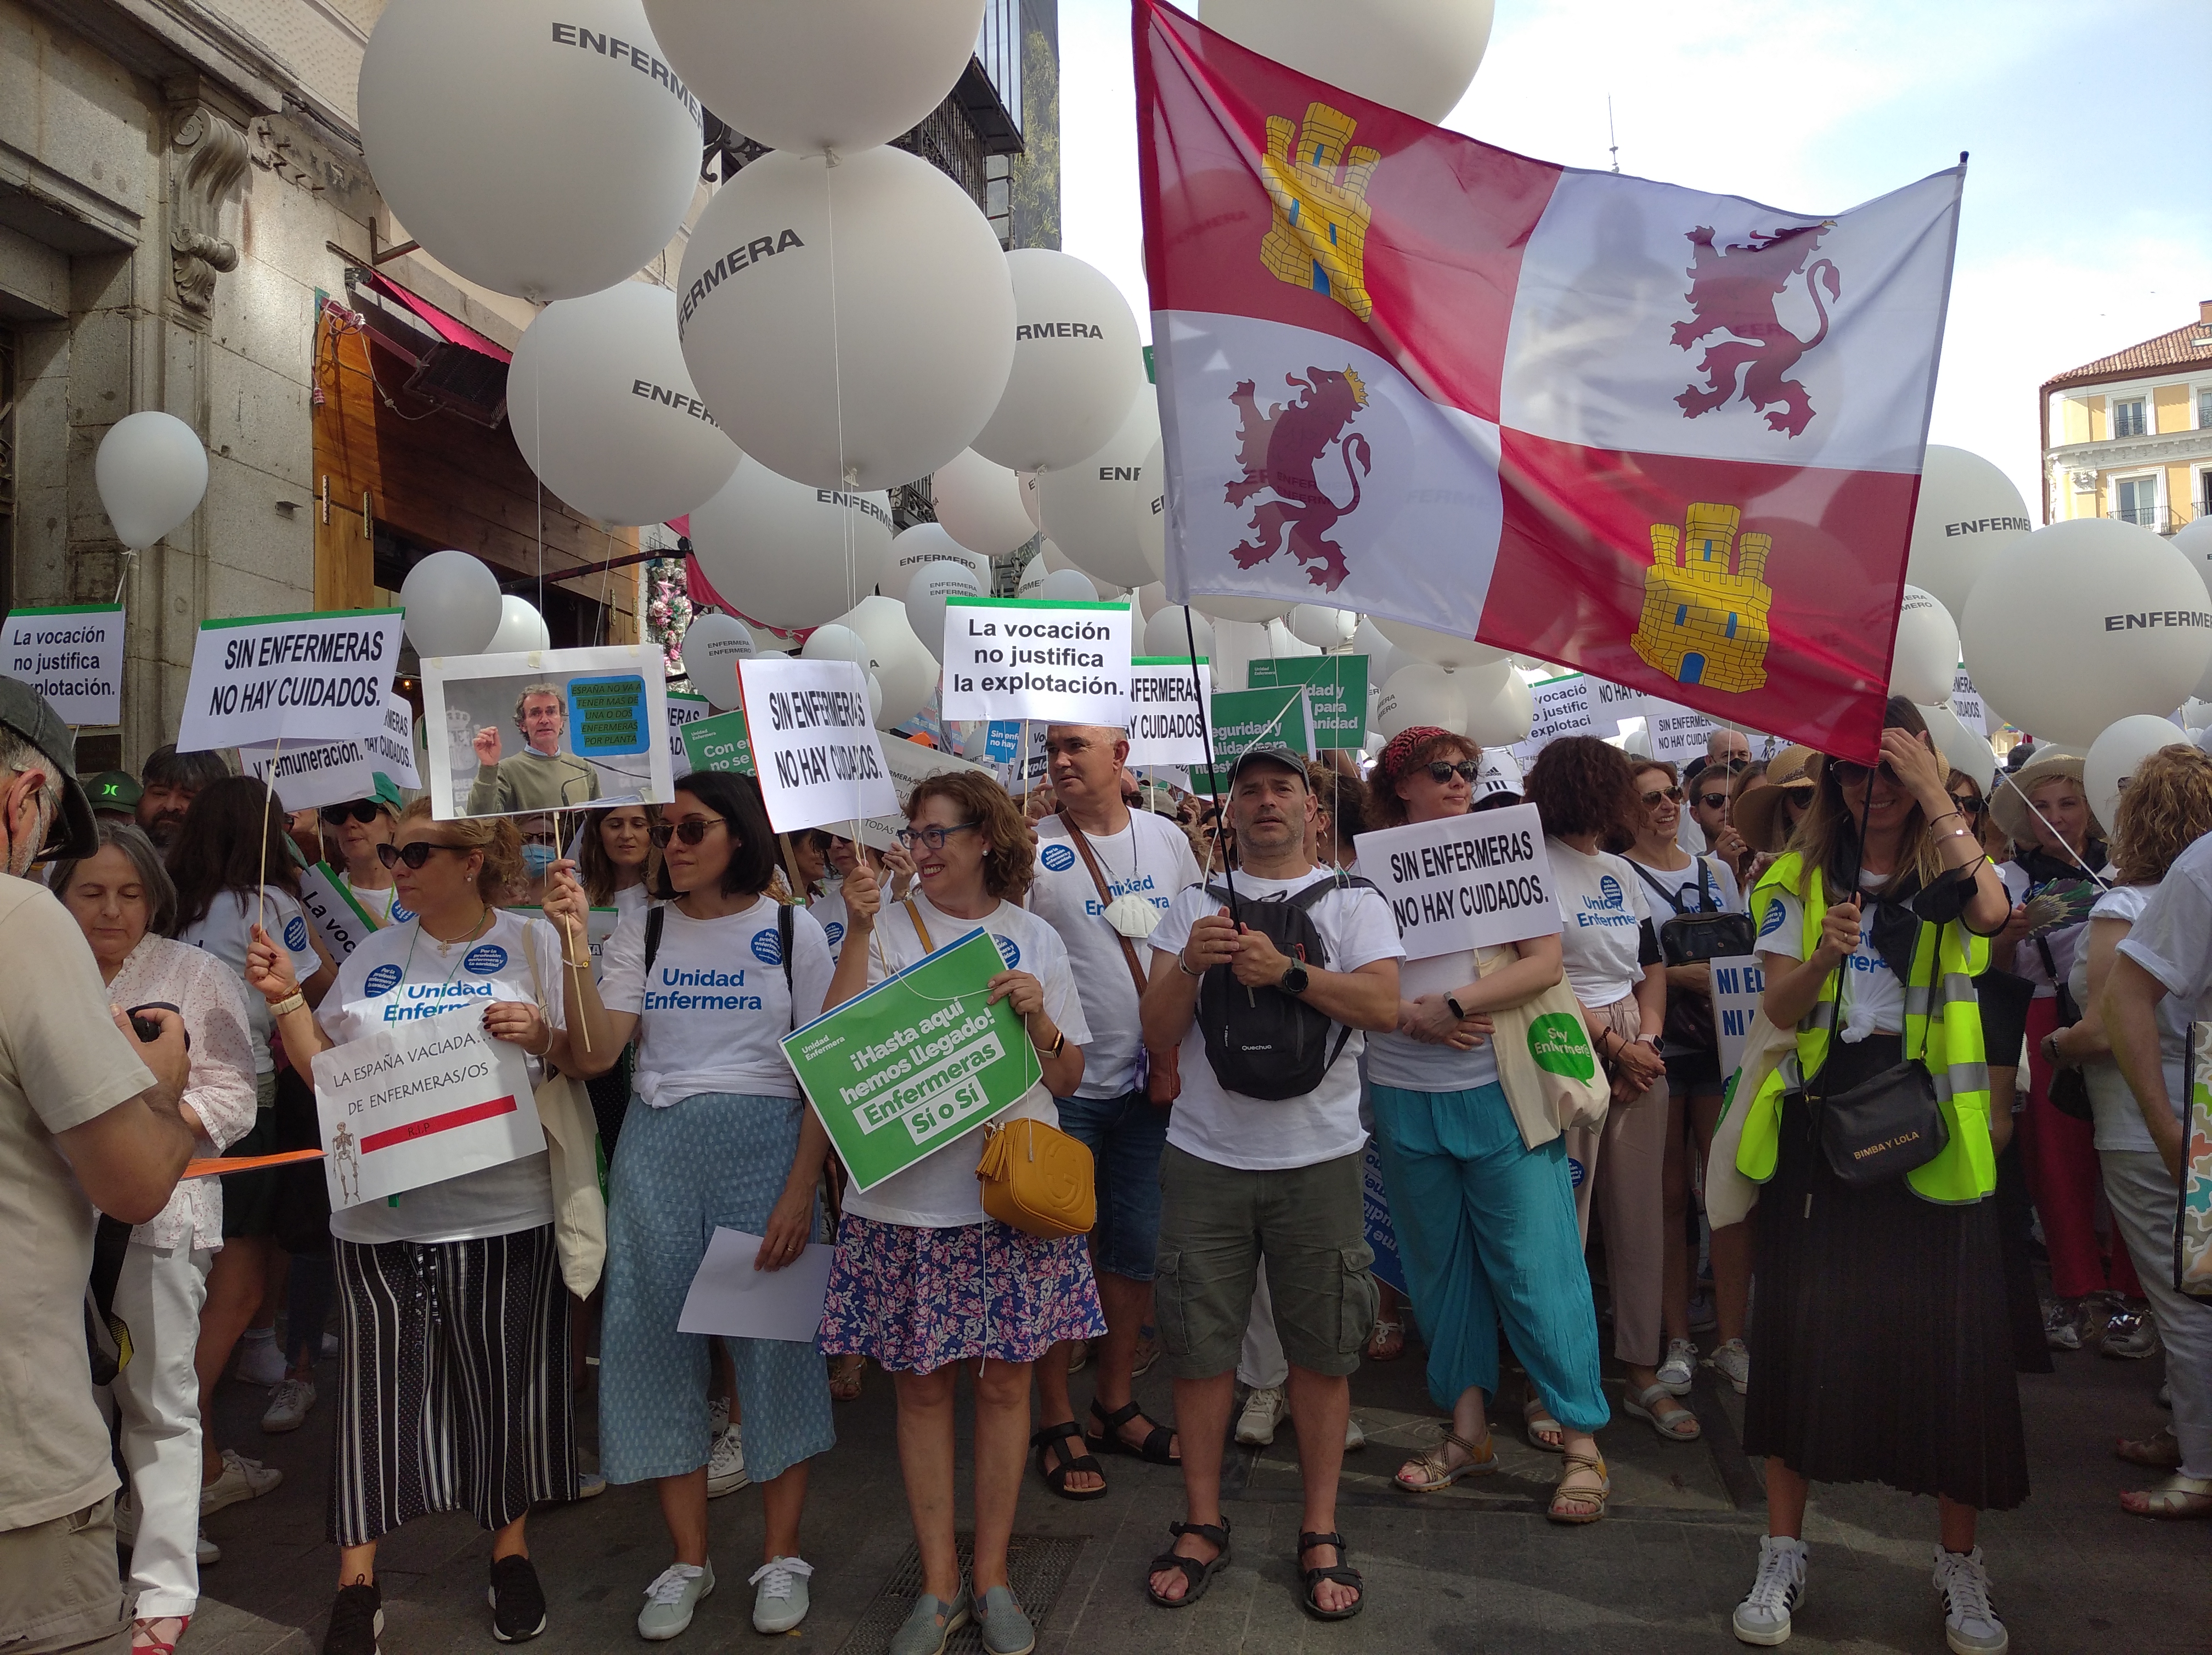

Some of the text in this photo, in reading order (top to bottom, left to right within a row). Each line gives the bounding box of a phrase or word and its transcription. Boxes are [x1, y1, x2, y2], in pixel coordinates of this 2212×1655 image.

[930, 582, 977, 592] ENFERMERA
[13, 626, 105, 646] La vocación
[968, 618, 1110, 640] La vocación
[224, 631, 384, 670] SIN ENFERMERAS
[707, 640, 750, 649] ENFERMERA
[709, 648, 751, 656] ENFERMERO
[14, 652, 100, 674] no justifica
[974, 646, 1104, 668] no justifica
[30, 678, 115, 696] plotación.
[572, 684, 605, 694] ESPAÑA
[953, 672, 1125, 696] la explotación.
[1336, 686, 1345, 699] y
[1599, 684, 1613, 703] NO
[209, 677, 380, 716] NO HAY CUIDADOS.
[577, 699, 603, 707] TENER
[585, 711, 604, 719] UNA
[769, 690, 866, 731] SIN ENFERMERAS
[1314, 703, 1347, 716] para
[1543, 701, 1588, 722] justific
[582, 722, 638, 732] ENFERMERAS
[1274, 723, 1282, 737] y
[1531, 714, 1591, 738] explotaci
[1658, 715, 1711, 731] SIN ENFERMER
[585, 735, 637, 745] POR PLANTA
[692, 731, 716, 740] Enfermera
[991, 730, 1003, 738] Sin
[1658, 736, 1669, 750] NO
[1671, 734, 1685, 747] HAY
[380, 735, 412, 768] CUIDADOS.
[704, 743, 734, 757] Con
[1001, 741, 1015, 750] hay
[267, 739, 364, 779] remuneración.
[710, 755, 749, 770] no se
[775, 744, 883, 789] NO HAY CUIDADOS.
[866, 819, 894, 835] TODAS
[1391, 830, 1533, 883] SIN ENFERMERAS
[302, 891, 327, 918] La
[1392, 875, 1549, 928] NO HAY CUIDADOS.
[663, 968, 744, 987] Unidad
[1717, 969, 1738, 995] NI
[407, 980, 493, 999] Unidad
[645, 991, 762, 1010] Enfermera
[1723, 1010, 1745, 1036] NI
[801, 1034, 830, 1054] Unidad
[849, 997, 965, 1072] ¡Hasta aquí
[1548, 1027, 1567, 1044] Soy
[805, 1036, 846, 1061] Enfermera
[839, 1007, 996, 1105] hemos llegado!
[1534, 1041, 1590, 1058] Enfermer@
[334, 1032, 492, 1088] LA ESPAÑA VACIADA...
[348, 1062, 488, 1116] DE ENFERMERAS/OS
[863, 1043, 996, 1127] Enfermeras
[911, 1083, 980, 1134] Sí o Sí
[1854, 1131, 1920, 1160] BIMBA Y LOLA
